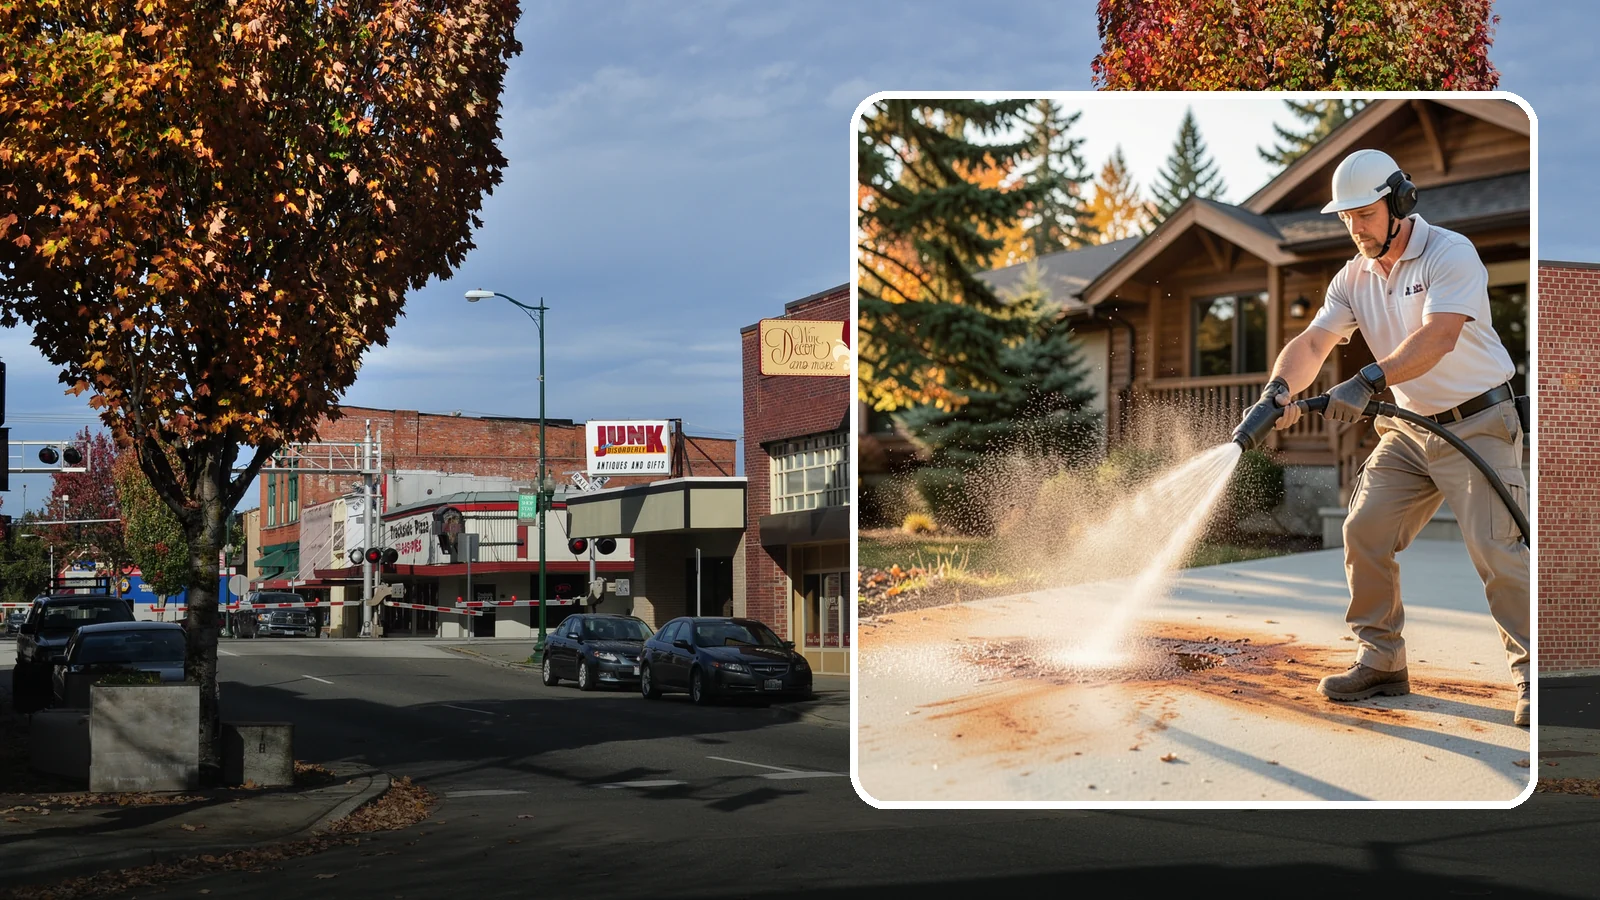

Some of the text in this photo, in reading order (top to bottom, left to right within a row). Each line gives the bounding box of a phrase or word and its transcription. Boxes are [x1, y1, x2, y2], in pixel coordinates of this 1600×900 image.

[595, 425, 666, 457] JUNK
[607, 446, 646, 454] DISORDERLY
[597, 460, 665, 470] ANTIQUES AND GIFTS
